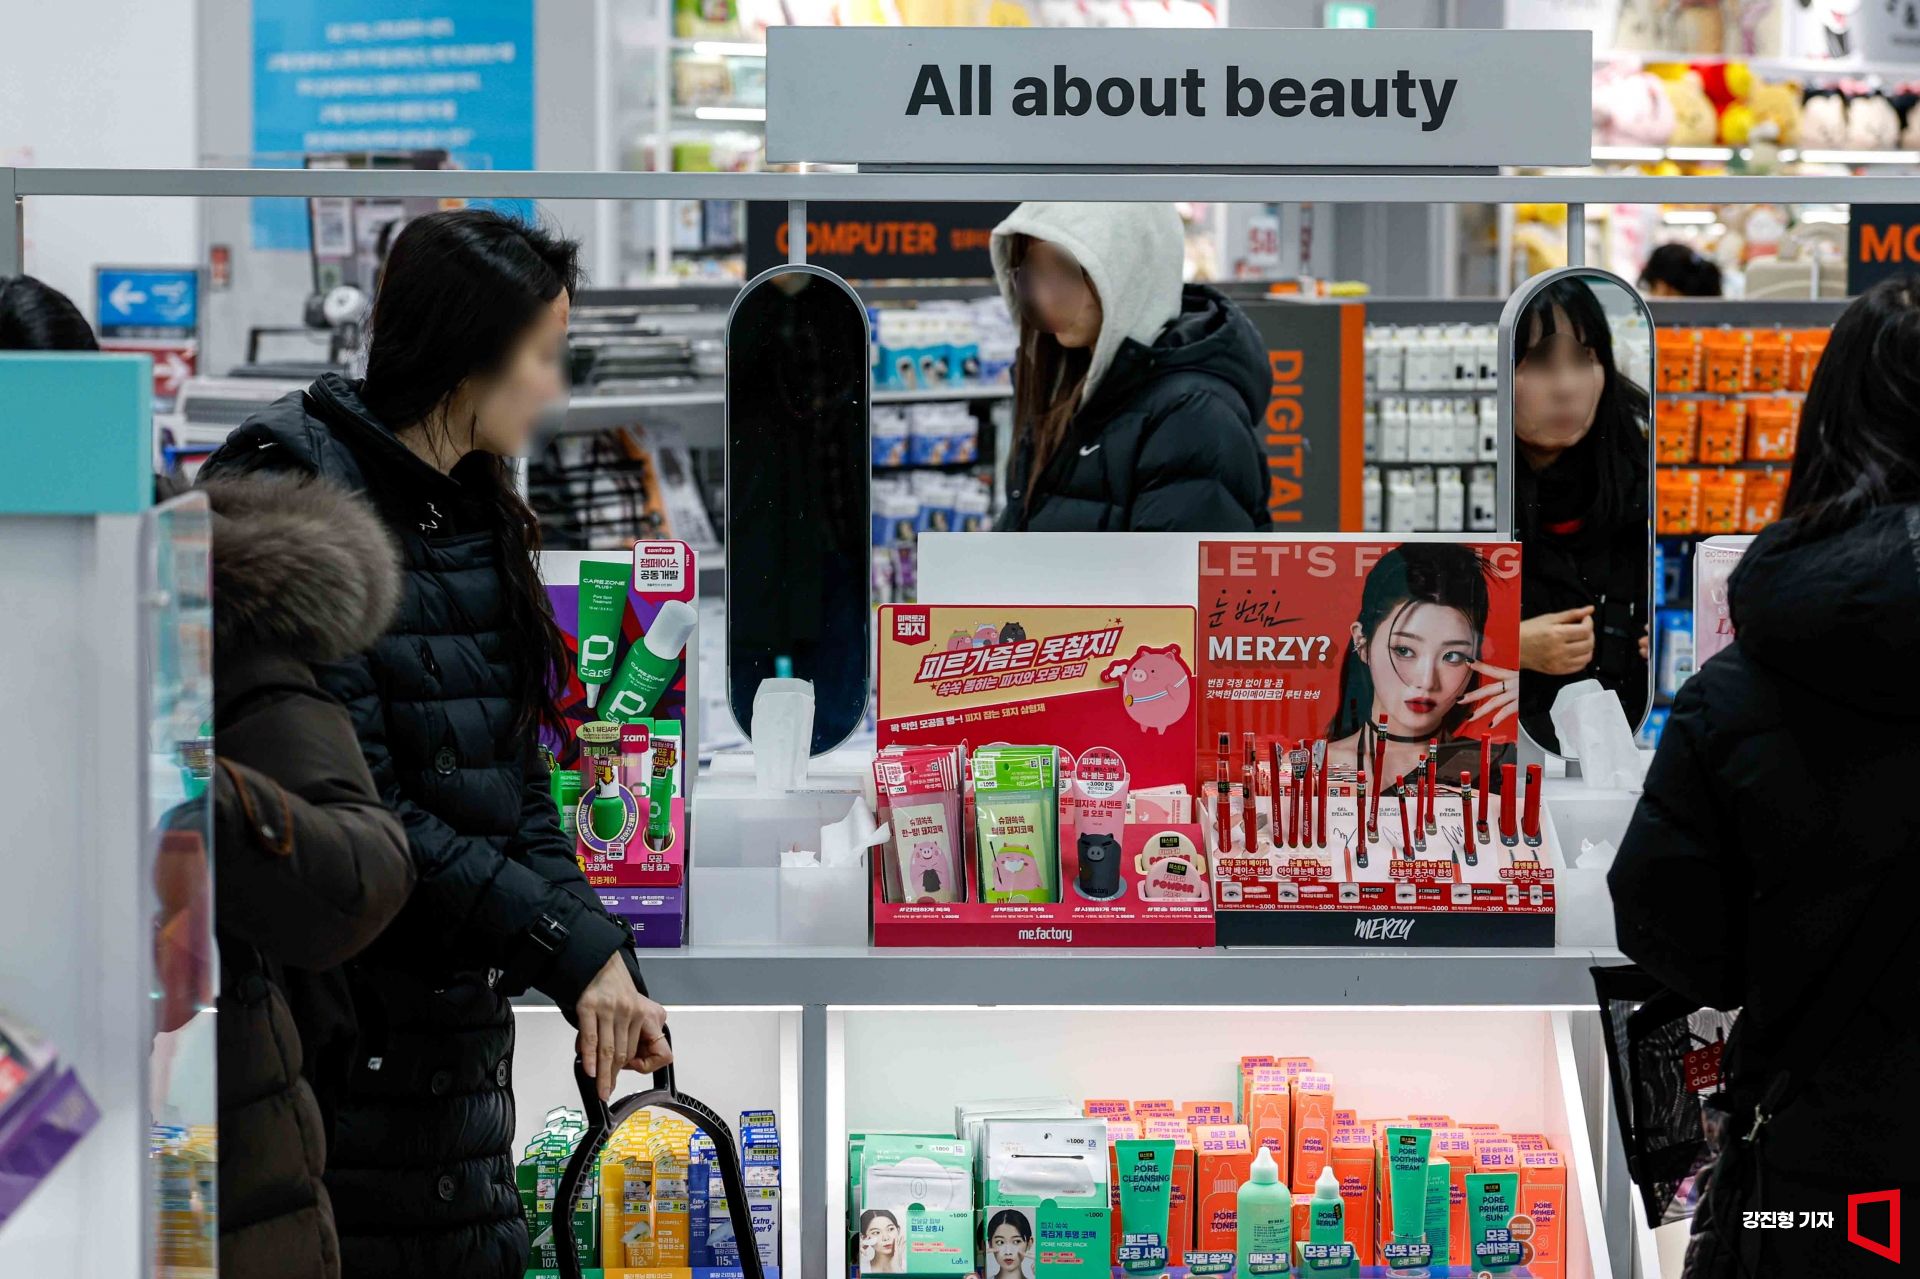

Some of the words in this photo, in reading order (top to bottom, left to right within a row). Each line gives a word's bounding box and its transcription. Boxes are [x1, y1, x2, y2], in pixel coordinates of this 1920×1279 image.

[905, 63, 992, 116] All
[1012, 64, 1206, 118] about
[1226, 65, 1458, 132] beauty
[775, 221, 938, 256] COMPUTER
[640, 558, 679, 569] 잼페이스
[1199, 545, 1337, 578] LET'S
[640, 570, 679, 581] 공동개발
[582, 577, 626, 587] CAREZONE
[897, 614, 926, 623] 미팩토리
[897, 622, 926, 637] 돼지
[1208, 635, 1331, 662] MERZY?
[917, 640, 1036, 681] 피르가즘은
[1038, 629, 1120, 664] 못참지!
[937, 681, 961, 696] 쏙쏙
[1001, 670, 1035, 687] 피지와
[1035, 667, 1061, 683] 모공
[1061, 664, 1087, 680] 관리
[1207, 678, 1223, 688] 번짐
[1226, 678, 1243, 688] 걱정
[1245, 678, 1261, 688] 없이
[1233, 690, 1283, 699] 아이메이크업
[1285, 690, 1301, 699] 루틴
[1303, 690, 1321, 699] 완성
[919, 716, 945, 729] 모공을
[964, 711, 983, 722] 피지
[982, 708, 1001, 720] 잡는
[1001, 706, 1020, 717] 돼지
[1020, 703, 1046, 715] 삼형제
[623, 734, 647, 743] zam
[1106, 772, 1120, 780] 피부
[1098, 800, 1123, 810] 시멘트
[920, 824, 944, 836] 돼지코팩
[1007, 825, 1034, 835] 돼지코팩
[648, 855, 662, 863] 모공
[586, 863, 614, 872] 모공개선
[641, 863, 654, 872] 토닝
[656, 863, 670, 872] 효과
[1233, 867, 1256, 875] 베이스
[1257, 867, 1272, 875] 완성
[1316, 867, 1331, 876] 완성
[1390, 868, 1413, 877] 오늘의
[1414, 868, 1436, 877] 추구미
[1437, 868, 1453, 877] 완성
[1152, 879, 1195, 893] POWDER
[1018, 926, 1073, 943] me.factory
[1354, 918, 1415, 941] MERZY
[1692, 1072, 1725, 1087] dais
[1187, 1115, 1208, 1125] 모공
[1210, 1115, 1230, 1124] 토너
[1352, 1135, 1371, 1144] 크림
[1203, 1141, 1224, 1151] 모공
[1226, 1140, 1247, 1150] 토너
[1451, 1141, 1470, 1150] 크림
[1390, 1156, 1426, 1164] SOOTHING
[1481, 1154, 1502, 1165] 톤업
[1504, 1154, 1515, 1165] 선
[1134, 1165, 1159, 1173] PORE
[1122, 1174, 1170, 1182] CLEANSING
[1133, 1185, 1160, 1193] FOAM
[1482, 1196, 1505, 1204] PORE
[1479, 1205, 1509, 1213] PRIMER
[752, 1216, 770, 1225] Extra
[1213, 1212, 1237, 1220] PORE
[1081, 1231, 1097, 1239] 코팩
[1486, 1229, 1509, 1242] 모공
[1119, 1247, 1141, 1260] 모공
[1143, 1247, 1166, 1260] 샤워
[1305, 1245, 1328, 1258] 모공
[1329, 1245, 1352, 1258] 실종
[1385, 1244, 1408, 1257] 산뜻
[1409, 1244, 1431, 1257] 모공
[1475, 1242, 1521, 1256] 숨바꼭질
[1185, 1252, 1208, 1264] 각질
[1250, 1253, 1274, 1265] 매끈
[1275, 1253, 1286, 1264] 결
